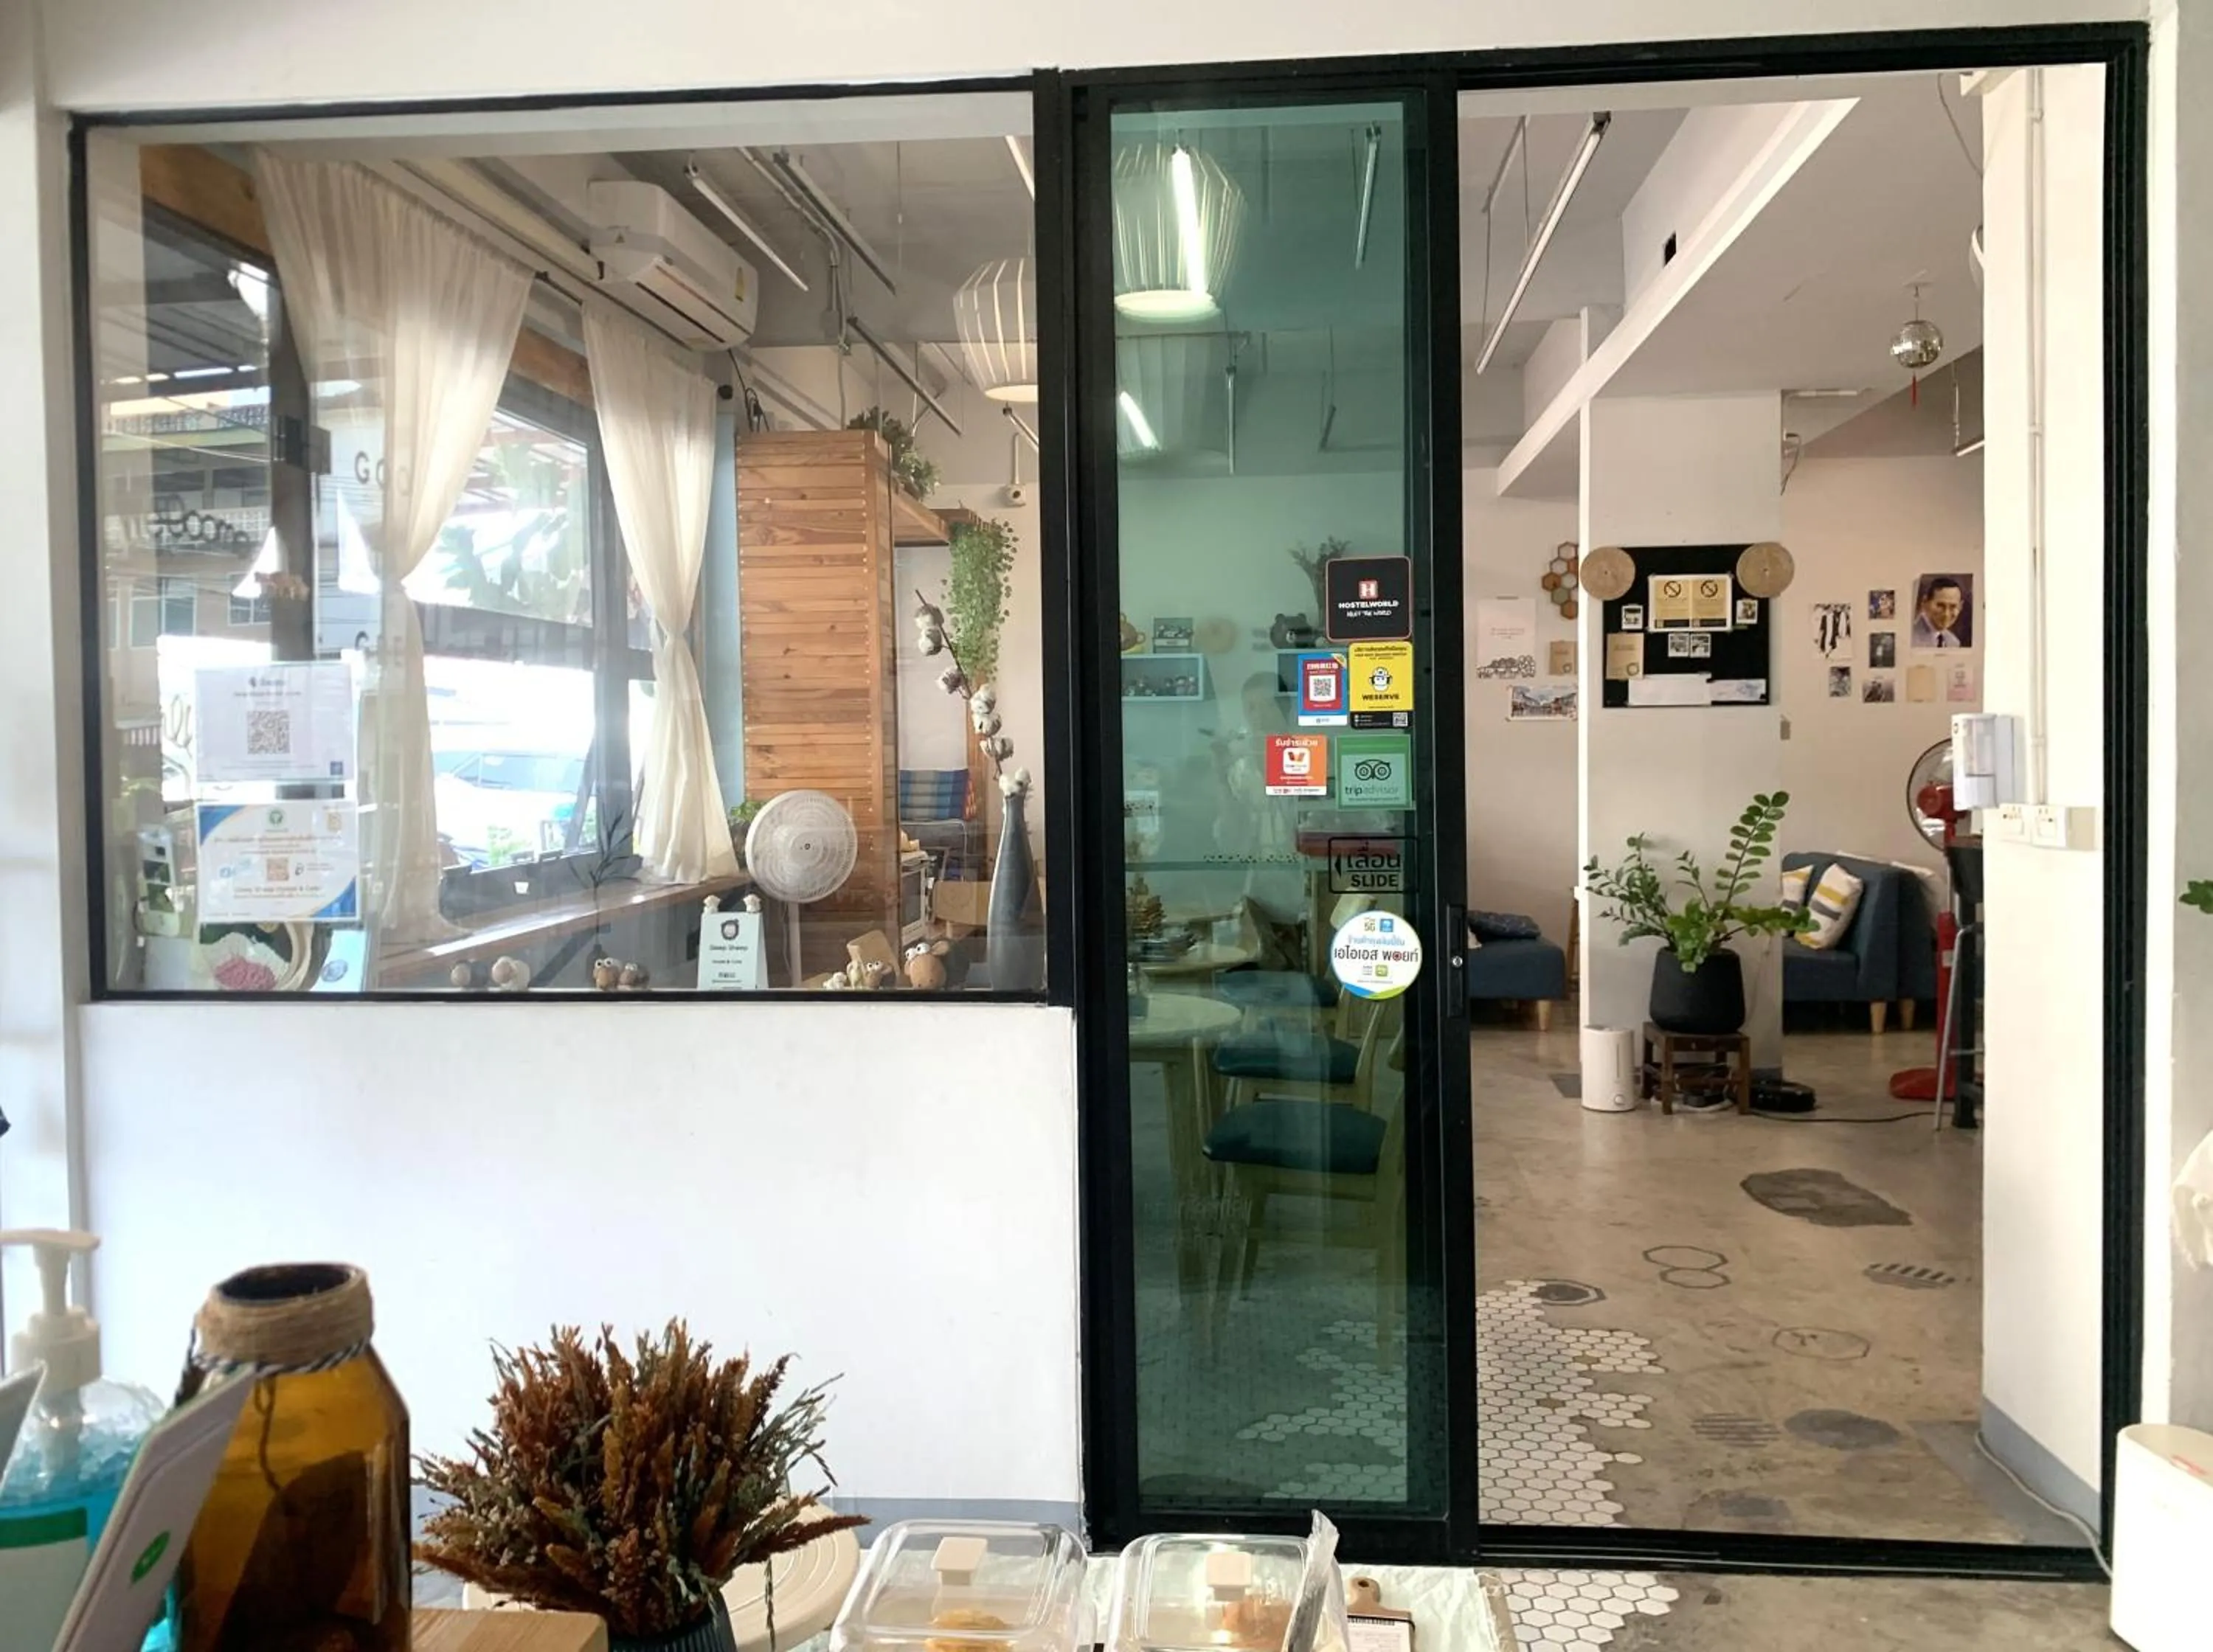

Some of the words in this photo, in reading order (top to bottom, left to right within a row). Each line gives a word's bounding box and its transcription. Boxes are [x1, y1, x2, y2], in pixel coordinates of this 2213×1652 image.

[1338, 600, 1399, 608] HOSTELWORLD
[1347, 841, 1401, 869] เลื่อน
[1351, 874, 1399, 887] SLIDE
